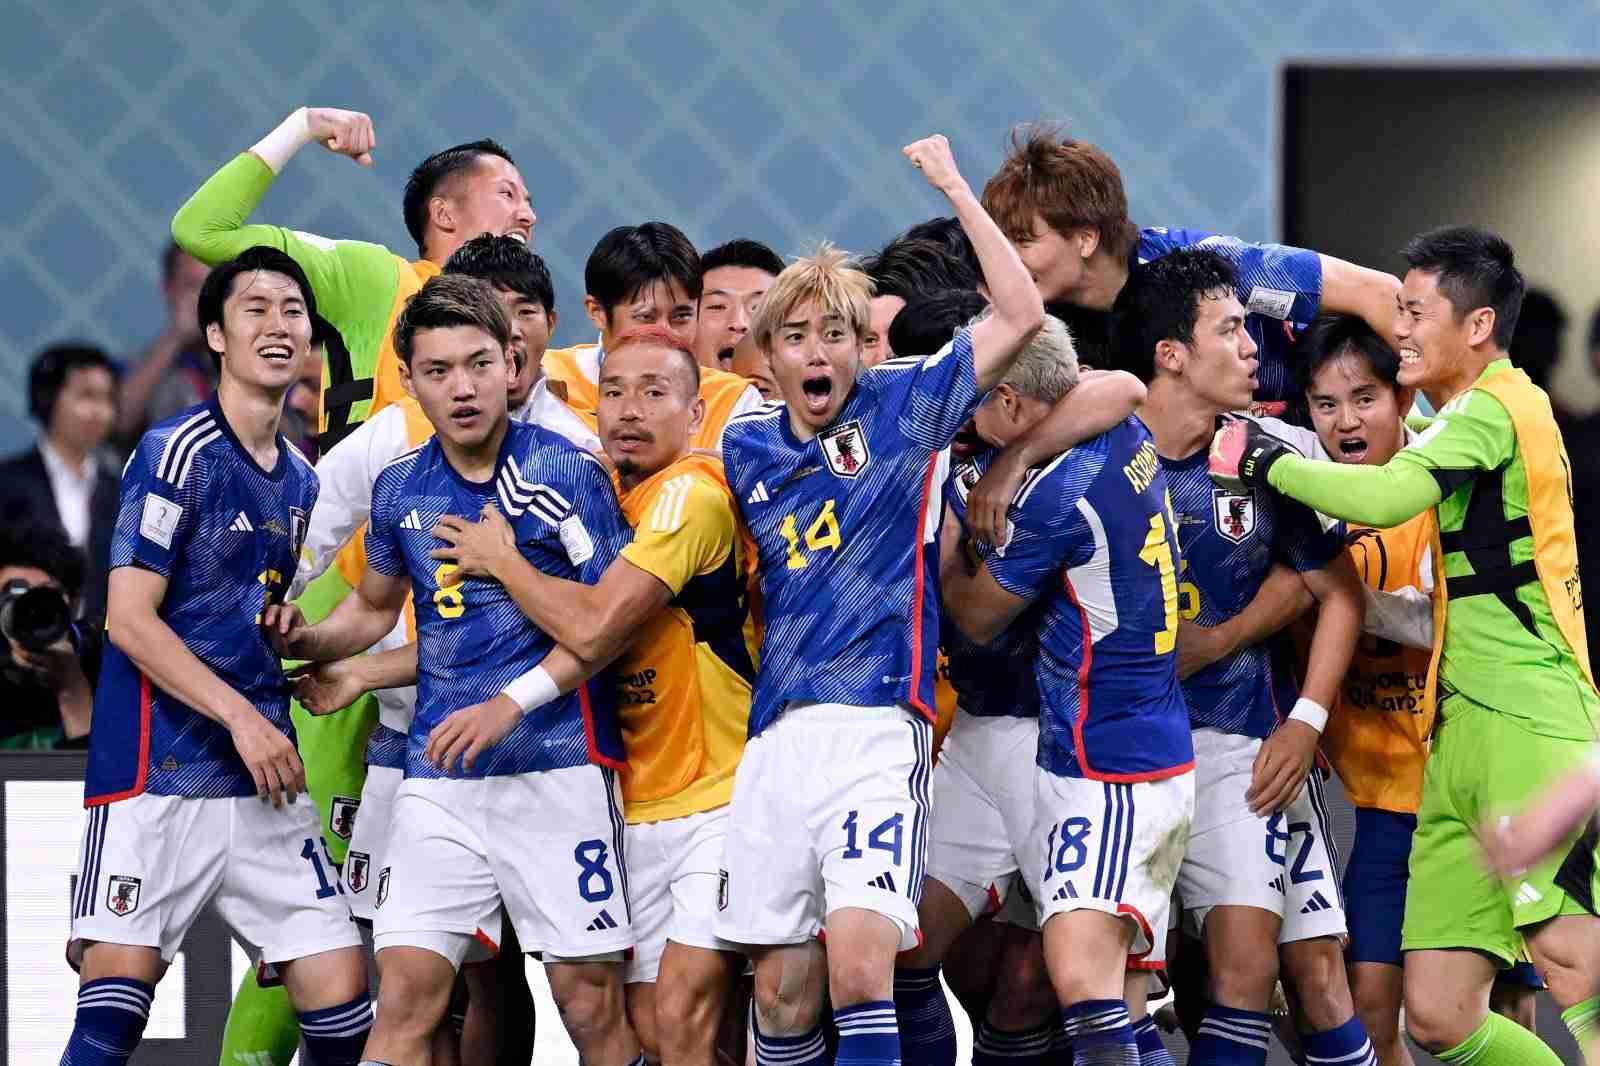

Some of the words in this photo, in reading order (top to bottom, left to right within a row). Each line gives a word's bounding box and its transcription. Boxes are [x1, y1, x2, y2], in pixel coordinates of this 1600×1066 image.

[779, 498, 842, 570] 14
[433, 563, 465, 619] 8
[574, 838, 614, 904] 8
[841, 809, 904, 867] 14
[1043, 816, 1093, 882] 18
